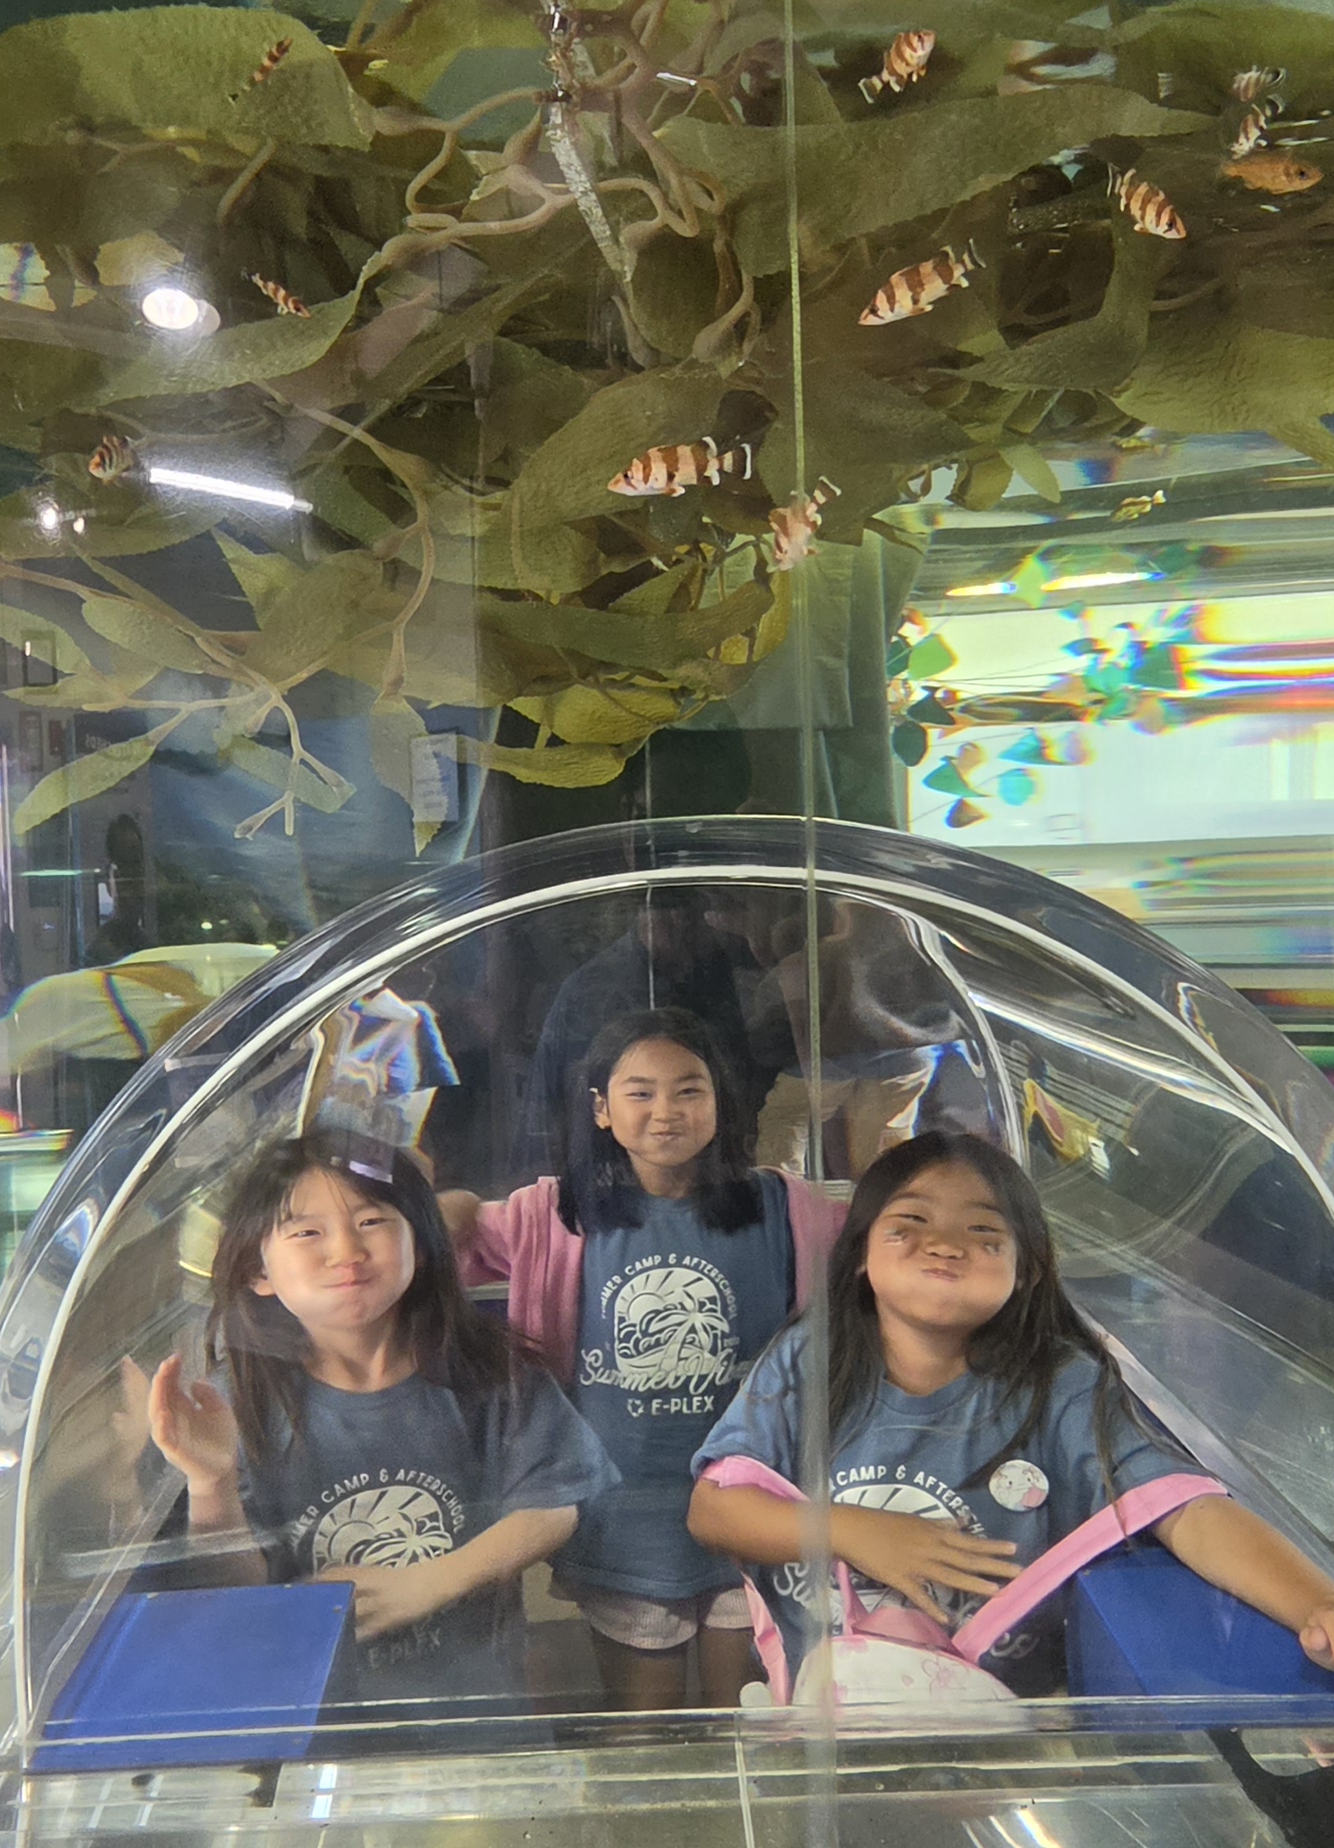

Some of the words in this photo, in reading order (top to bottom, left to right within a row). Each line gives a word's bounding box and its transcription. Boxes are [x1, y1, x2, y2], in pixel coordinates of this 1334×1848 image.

[600, 1275, 623, 1319] MMER
[625, 1254, 662, 1276] CAMP
[668, 1253, 678, 1265] &
[682, 1255, 740, 1320] AFTERSCHOOL
[651, 1395, 716, 1416] E-PLEX
[836, 1464, 887, 1487] CAMP
[895, 1464, 907, 1480] &
[321, 1473, 370, 1504] CAMP
[379, 1468, 389, 1483] &
[395, 1468, 466, 1535] AFTERSCHOOL
